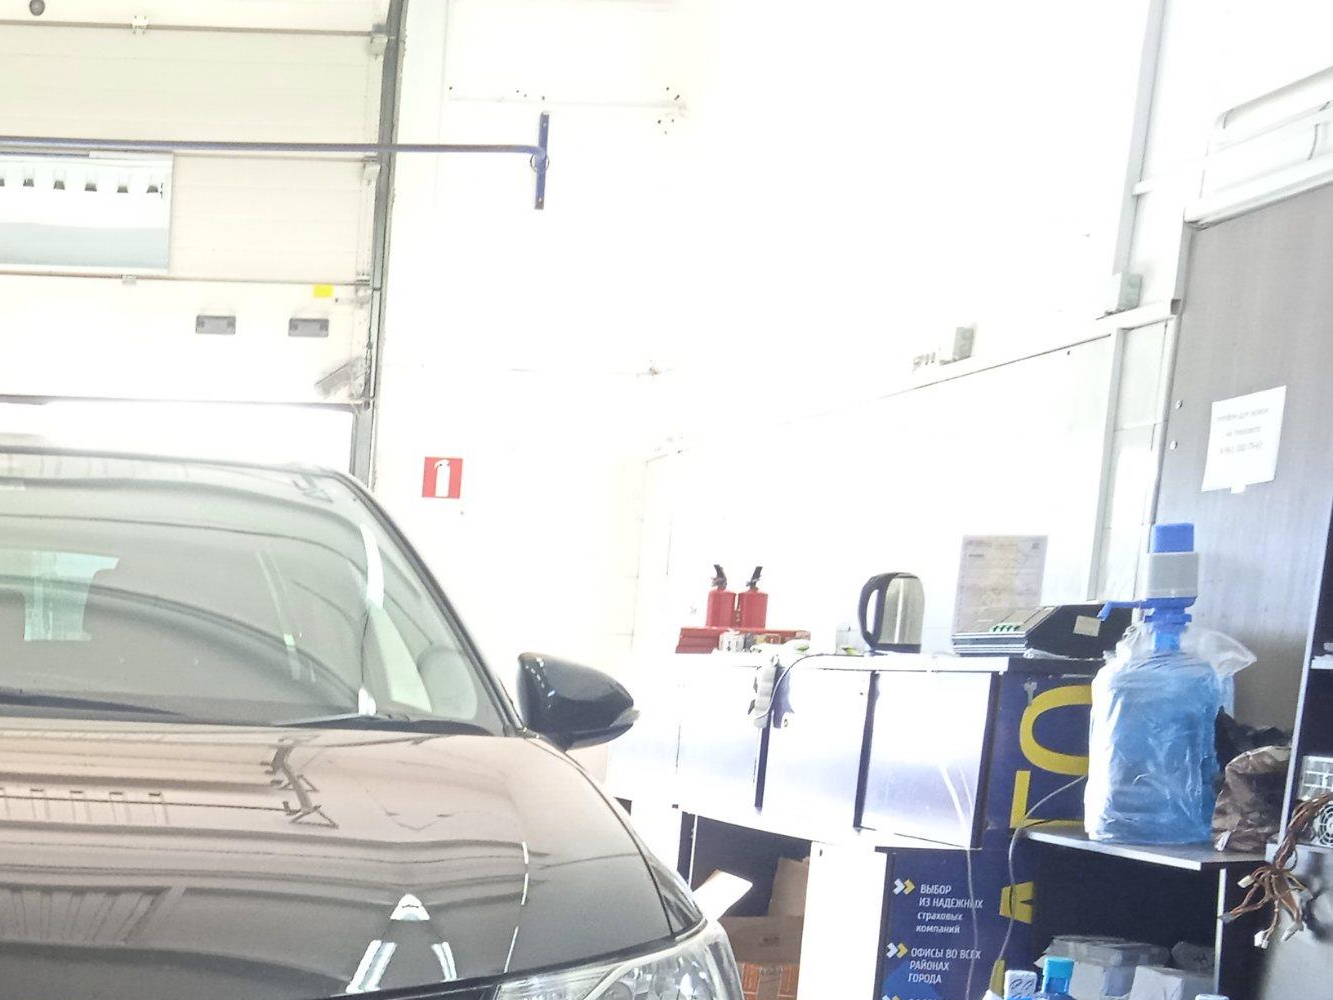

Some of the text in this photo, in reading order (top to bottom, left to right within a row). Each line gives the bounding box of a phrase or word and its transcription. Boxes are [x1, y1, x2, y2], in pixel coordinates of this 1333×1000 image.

[920, 884, 952, 895] ВЫБОР
[919, 897, 930, 907] ИЗ
[917, 912, 963, 922] страховых
[915, 924, 961, 934] компаний
[910, 947, 982, 960] ОФИСЫ ВО ВСЕХ
[909, 959, 950, 971] РАЙОНАХ
[908, 972, 942, 984] ГОРОДА
